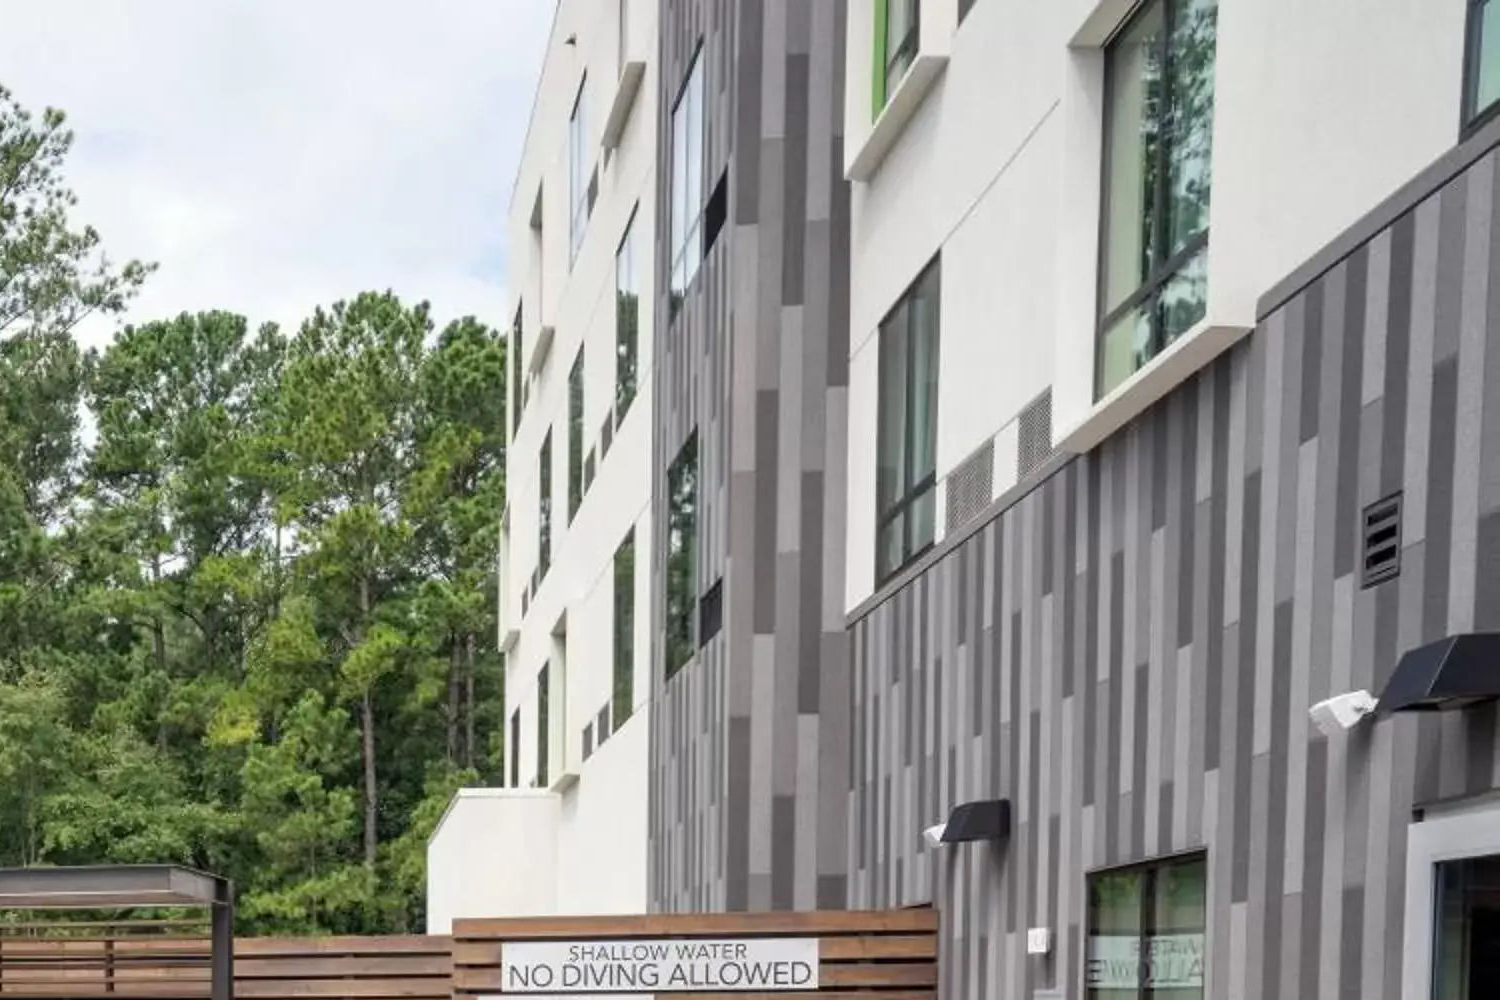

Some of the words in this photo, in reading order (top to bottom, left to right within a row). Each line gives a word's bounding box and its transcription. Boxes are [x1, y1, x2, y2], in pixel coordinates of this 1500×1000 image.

[569, 945, 670, 961] SHALLOW
[675, 943, 747, 960] WATER
[509, 964, 553, 987] NO
[562, 962, 659, 987] DIVING
[668, 961, 812, 986] ALLOWED
